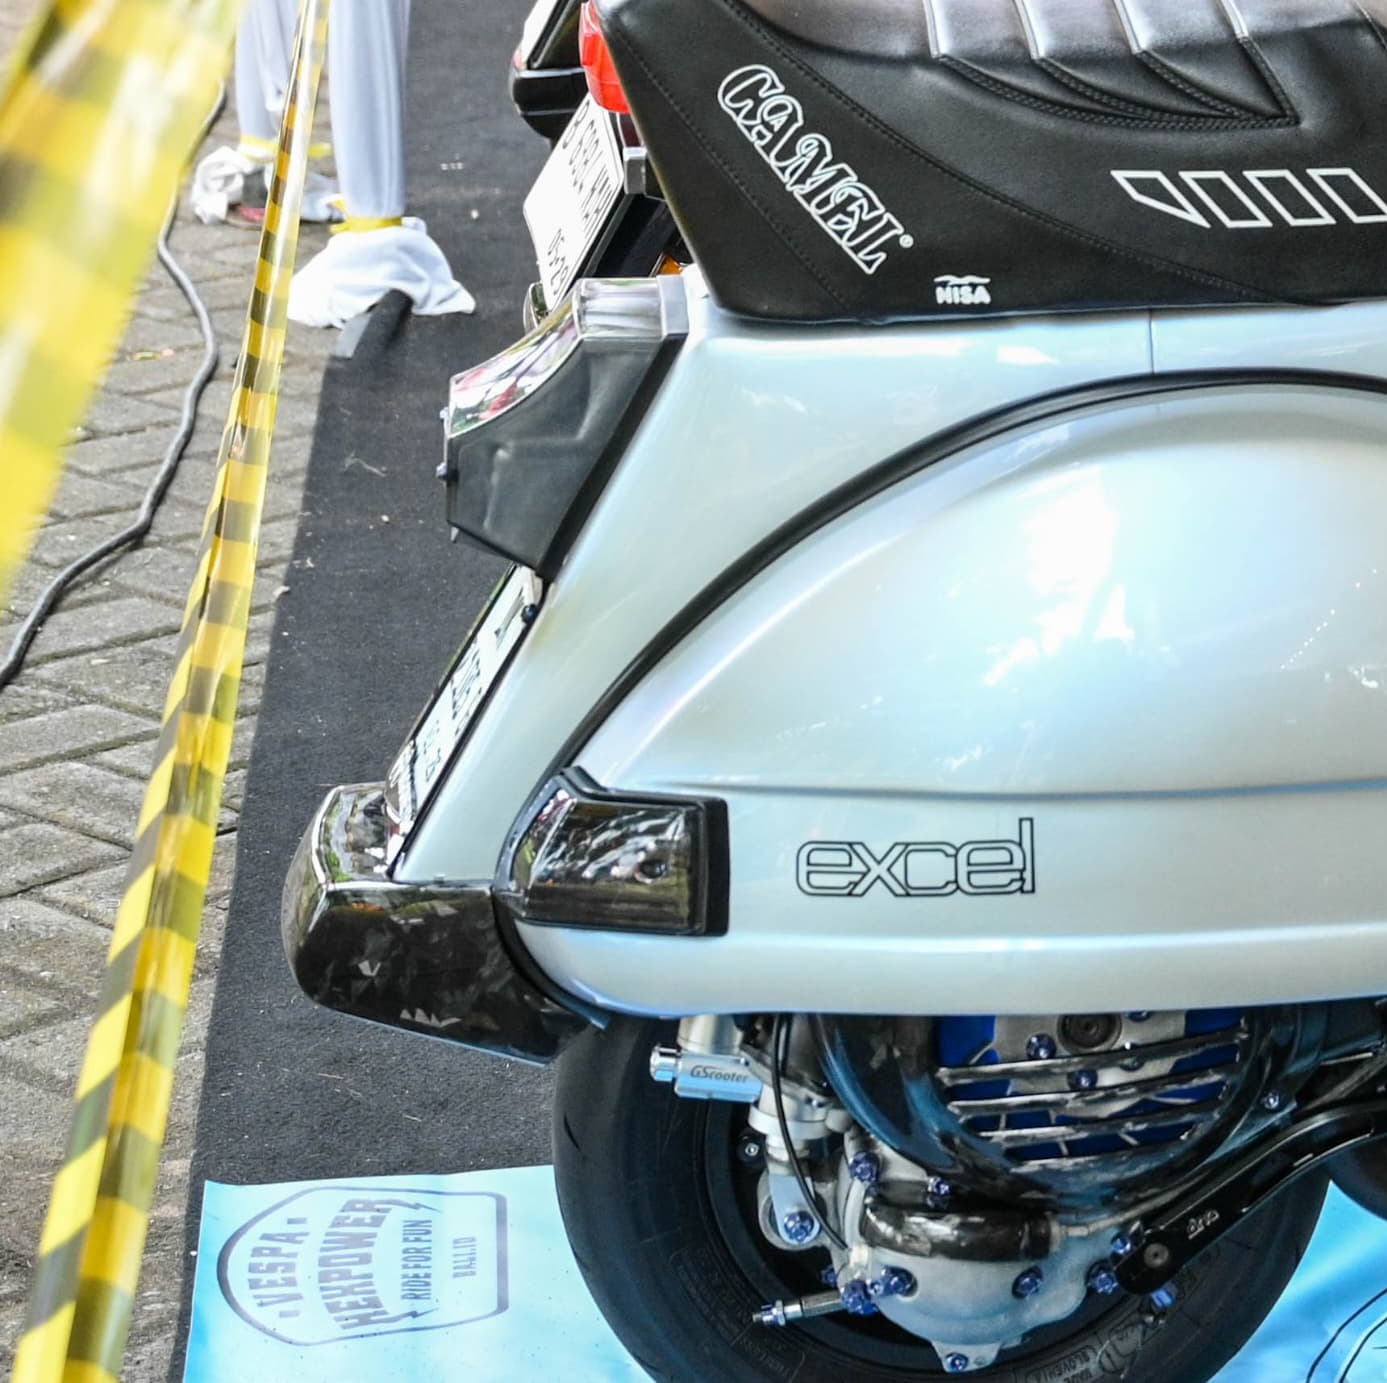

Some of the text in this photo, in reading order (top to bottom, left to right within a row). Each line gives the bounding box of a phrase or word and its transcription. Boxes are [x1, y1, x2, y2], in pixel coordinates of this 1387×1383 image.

[796, 816, 1036, 898] excel
[247, 1231, 310, 1308] VESPA
[401, 1219, 432, 1300] RIDE FOR FUN
